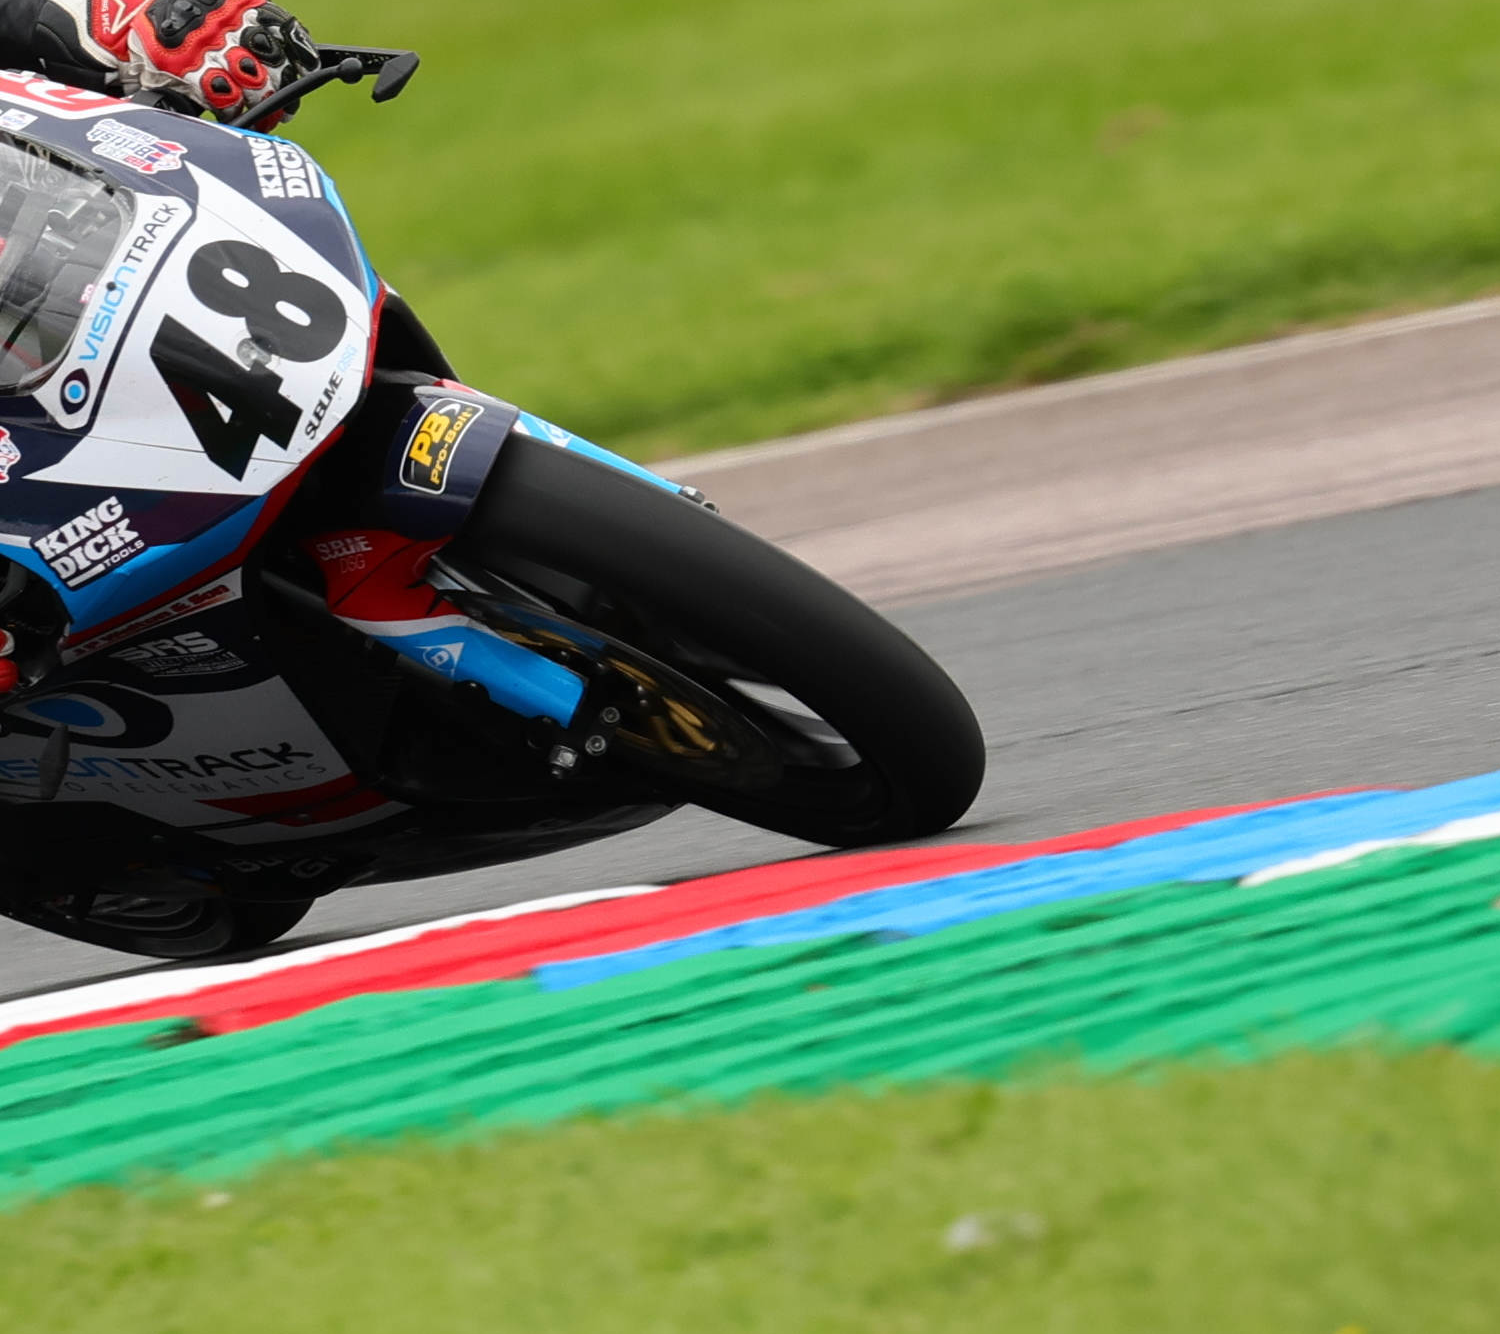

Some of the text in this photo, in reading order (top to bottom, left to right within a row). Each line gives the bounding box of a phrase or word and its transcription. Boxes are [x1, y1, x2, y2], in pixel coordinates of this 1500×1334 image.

[248, 138, 285, 198] KING
[150, 240, 348, 482] 48
[304, 371, 343, 440] SUBLIME
[409, 412, 450, 467] PB
[34, 495, 123, 560] KING
[50, 518, 139, 579] DICK
[104, 539, 145, 568] TOOLS
[108, 630, 220, 661] SRS
[101, 762, 328, 795] TELEMATICS
